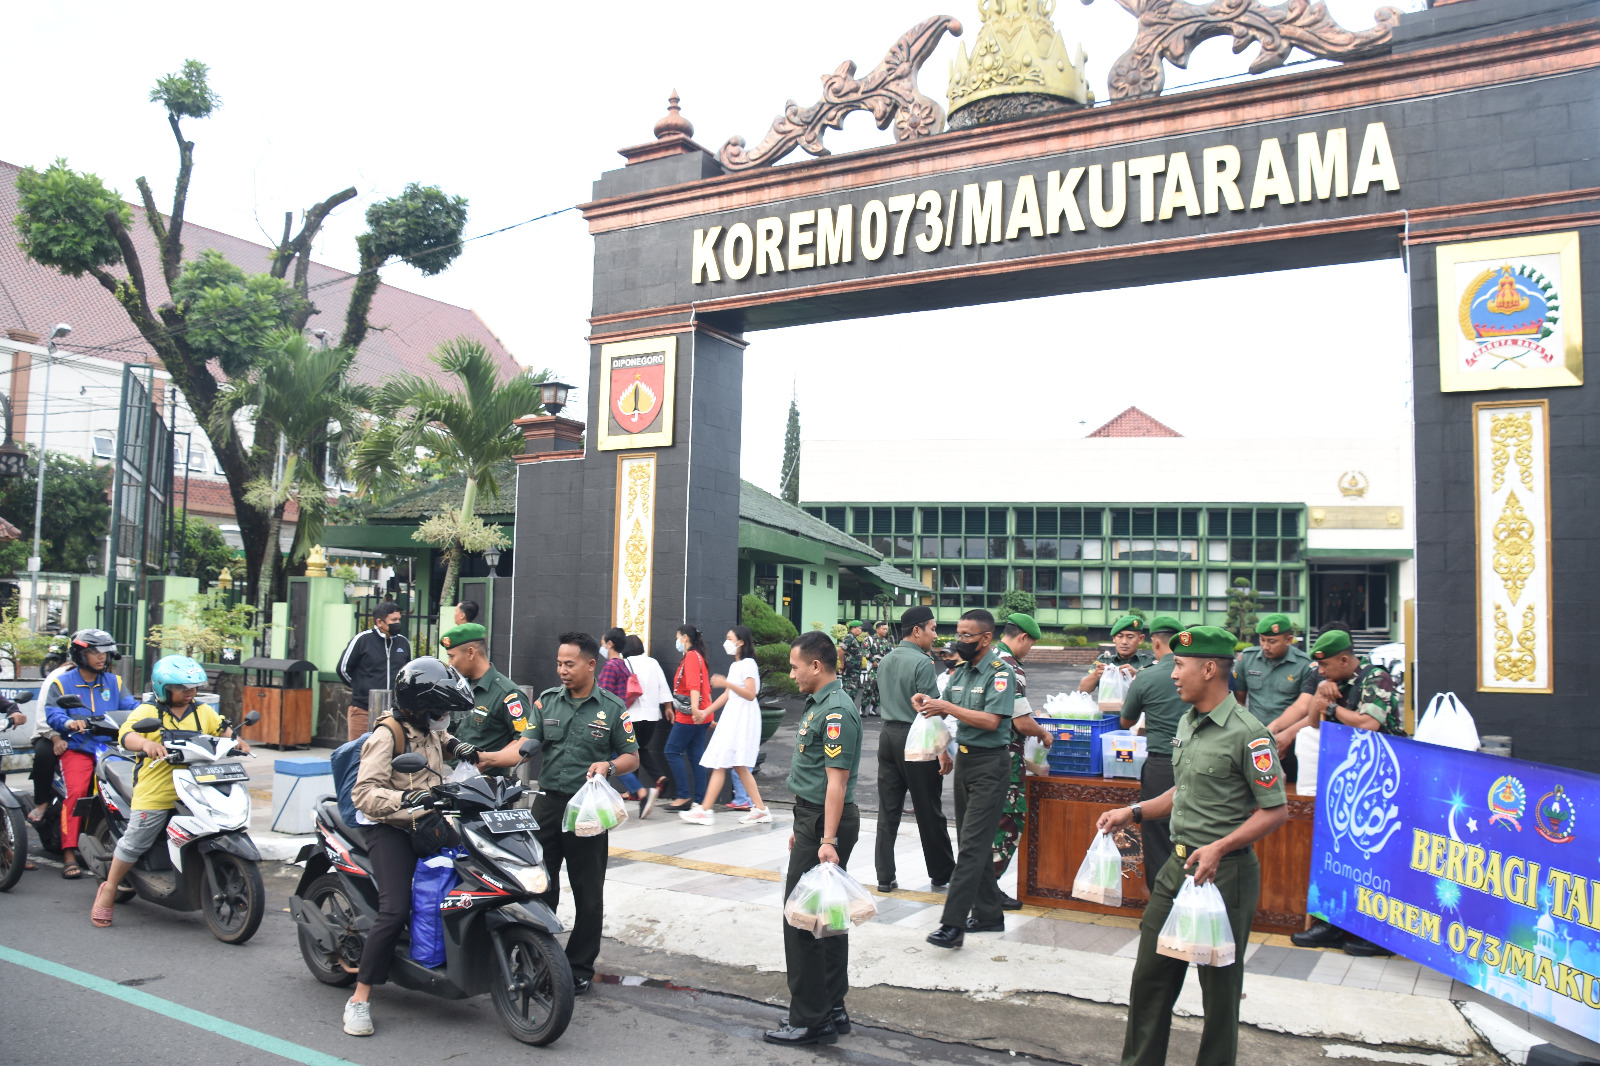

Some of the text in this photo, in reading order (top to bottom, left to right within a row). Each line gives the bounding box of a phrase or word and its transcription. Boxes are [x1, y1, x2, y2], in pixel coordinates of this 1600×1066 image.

[691, 121, 1401, 285] KOREM 073/MAKUTARAMA
[612, 354, 664, 368] DIPONEGORO
[1, 688, 22, 700] TIG
[481, 873, 503, 889] HONDA
[1324, 851, 1391, 894] Ramadan
[1410, 828, 1541, 910] BERBAGI
[1355, 885, 1600, 1010] KOREM 073/MAKU
